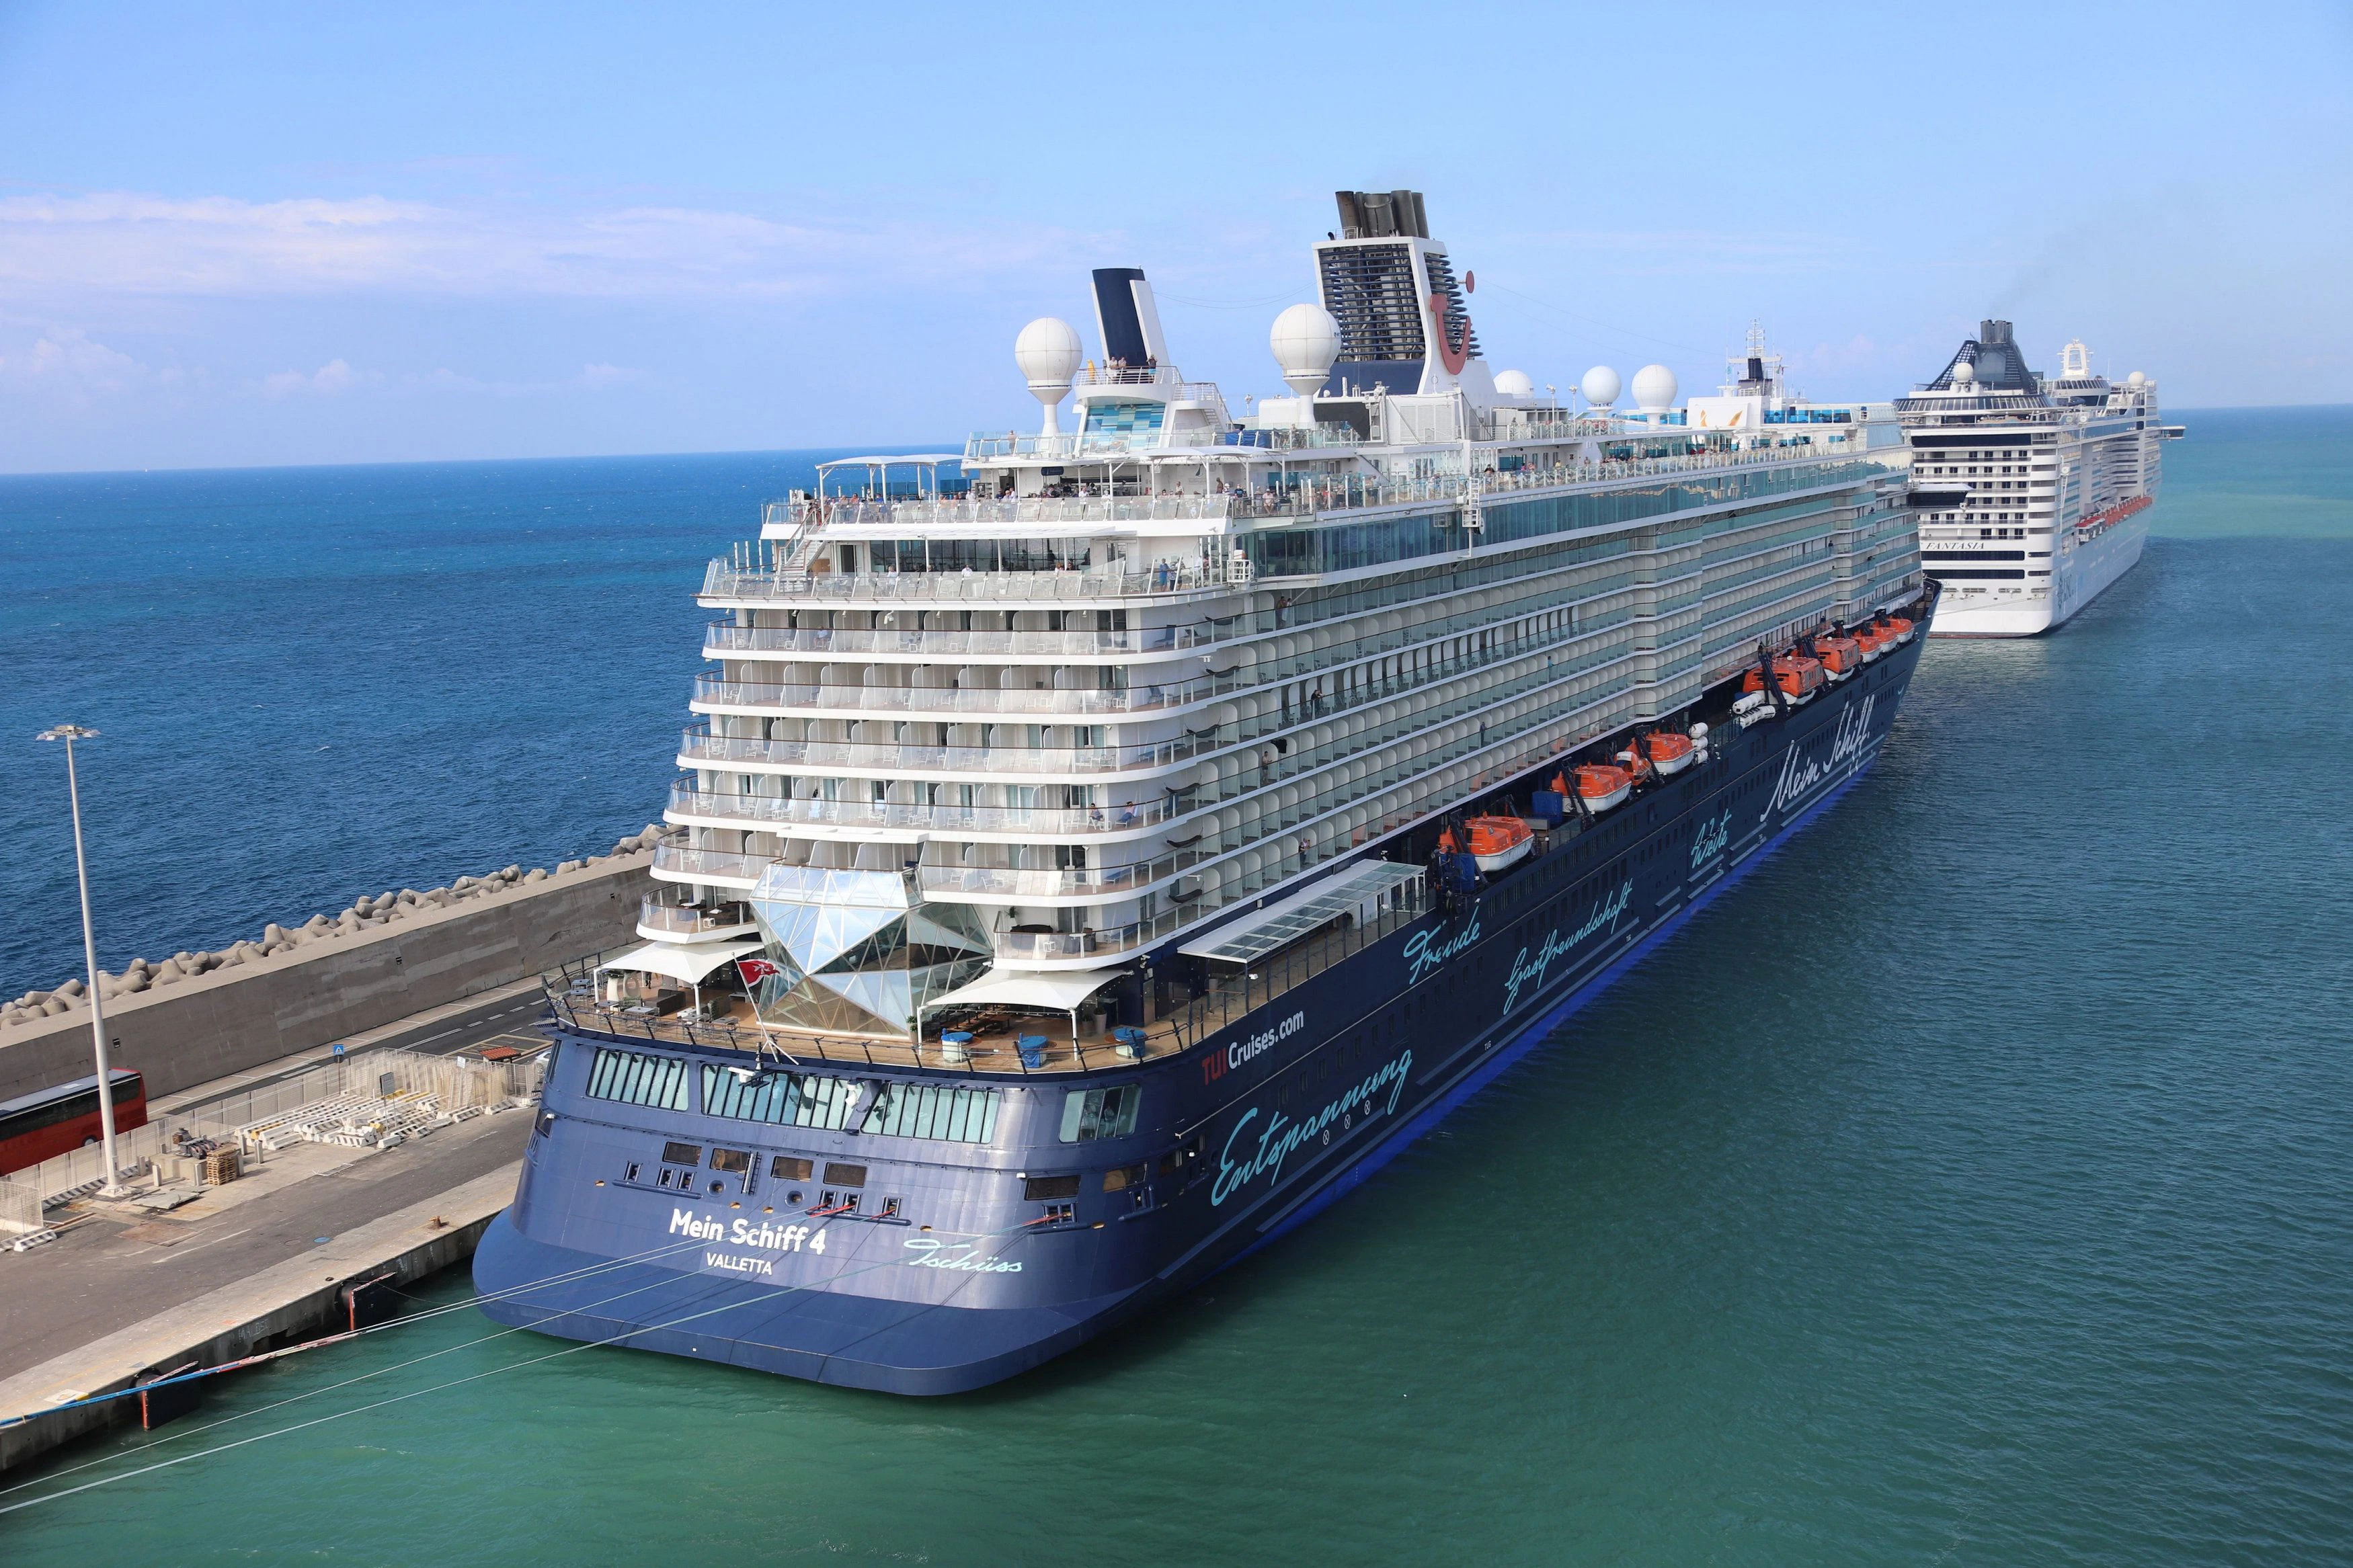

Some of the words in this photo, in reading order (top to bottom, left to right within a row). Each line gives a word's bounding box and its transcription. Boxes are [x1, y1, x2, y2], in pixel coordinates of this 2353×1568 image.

[1925, 542, 1985, 550] FANTASIA
[1759, 739, 1821, 823] Mein
[1402, 905, 1480, 985] Freude
[1503, 878, 1633, 1016] Gastfreundschaft
[1211, 1048, 1412, 1206] Entspannung
[669, 1208, 724, 1241] Mein
[729, 1218, 809, 1252] Schiff
[809, 1228, 827, 1255] 4
[903, 1238, 1023, 1272] Tschüss
[707, 1251, 773, 1276] VALLETTA
